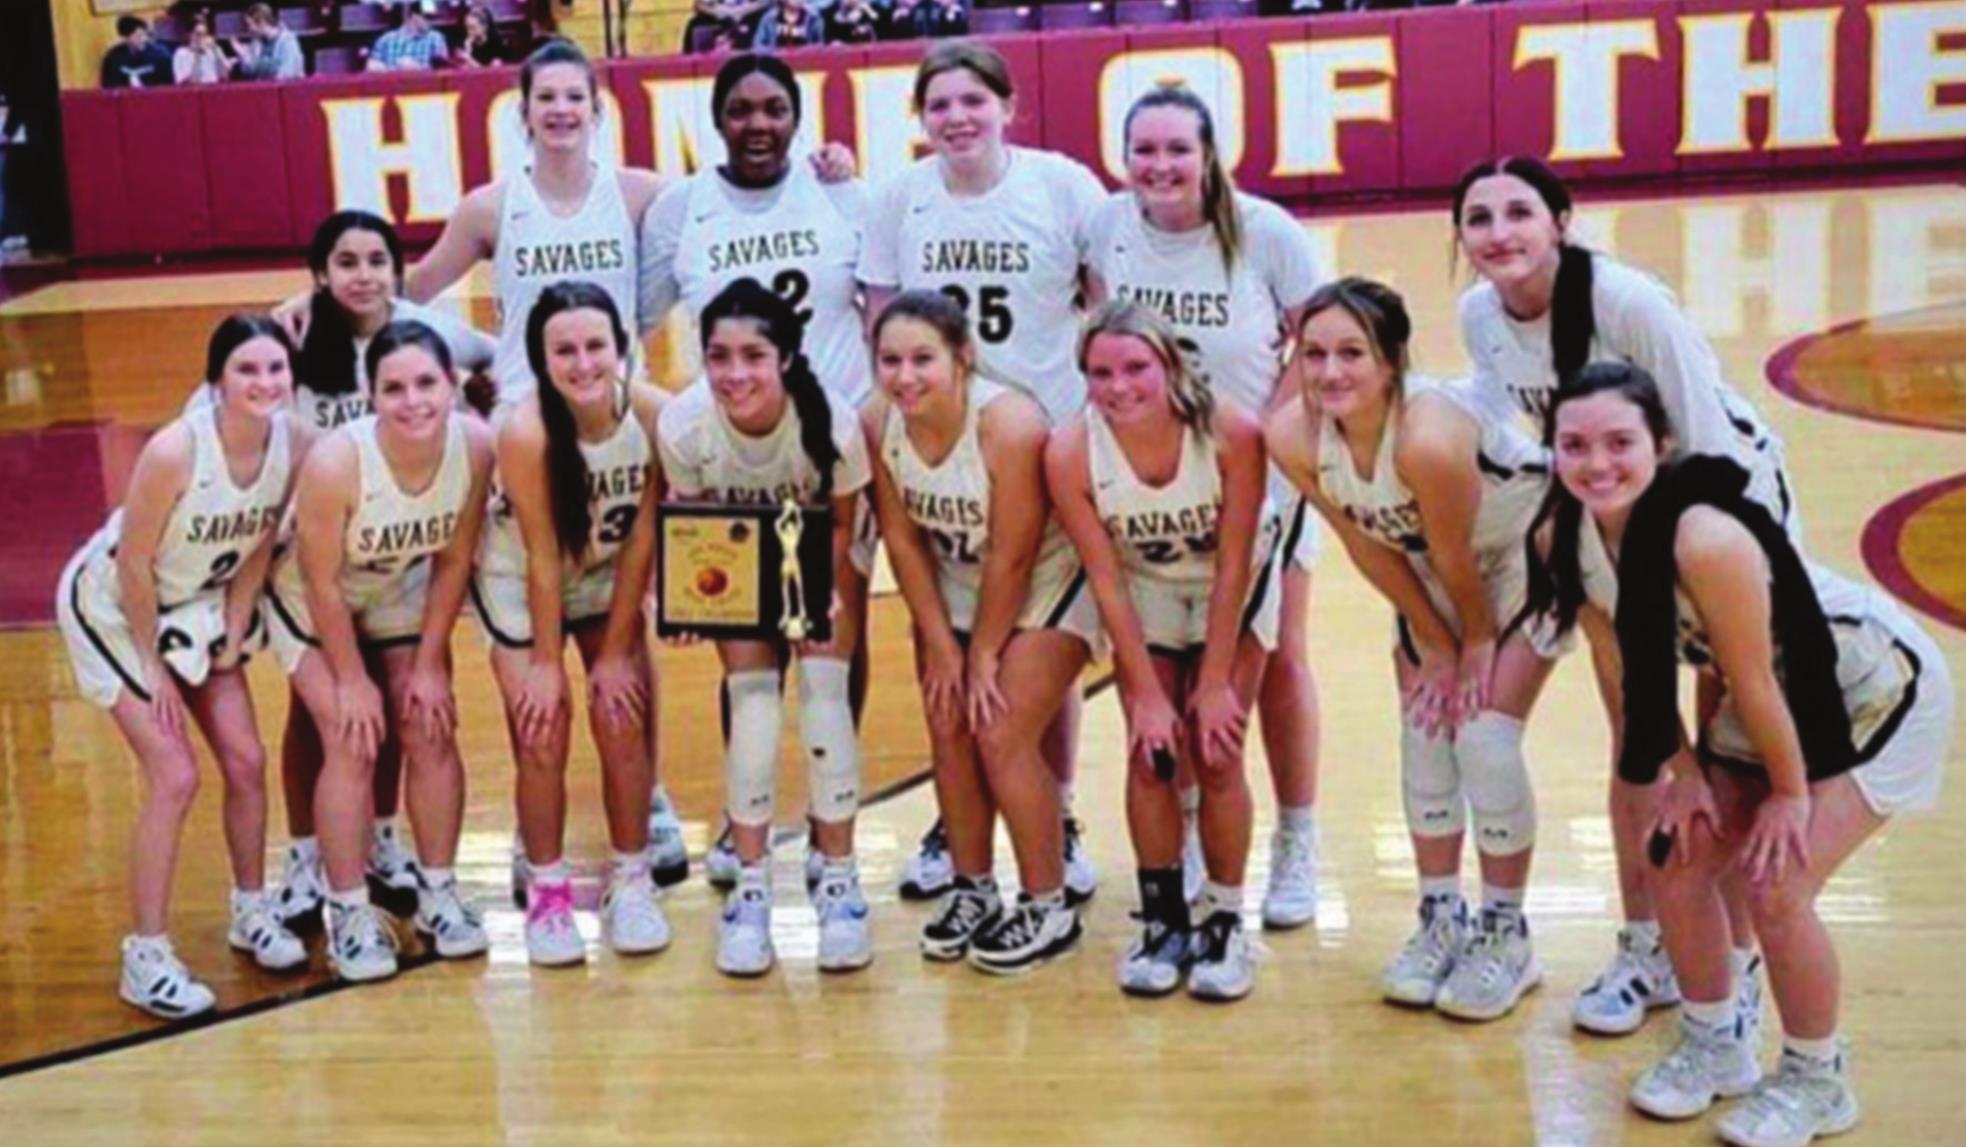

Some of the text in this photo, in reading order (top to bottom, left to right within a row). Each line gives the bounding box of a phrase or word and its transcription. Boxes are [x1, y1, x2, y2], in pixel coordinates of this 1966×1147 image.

[1100, 36, 1397, 191] OF
[1512, 2, 1966, 162] THE
[516, 239, 623, 277] SAVAGES
[708, 230, 819, 272] SAVAGES
[922, 240, 1030, 273] SAVAGES
[358, 513, 455, 553] SAVAGE
[201, 551, 239, 590] 2
